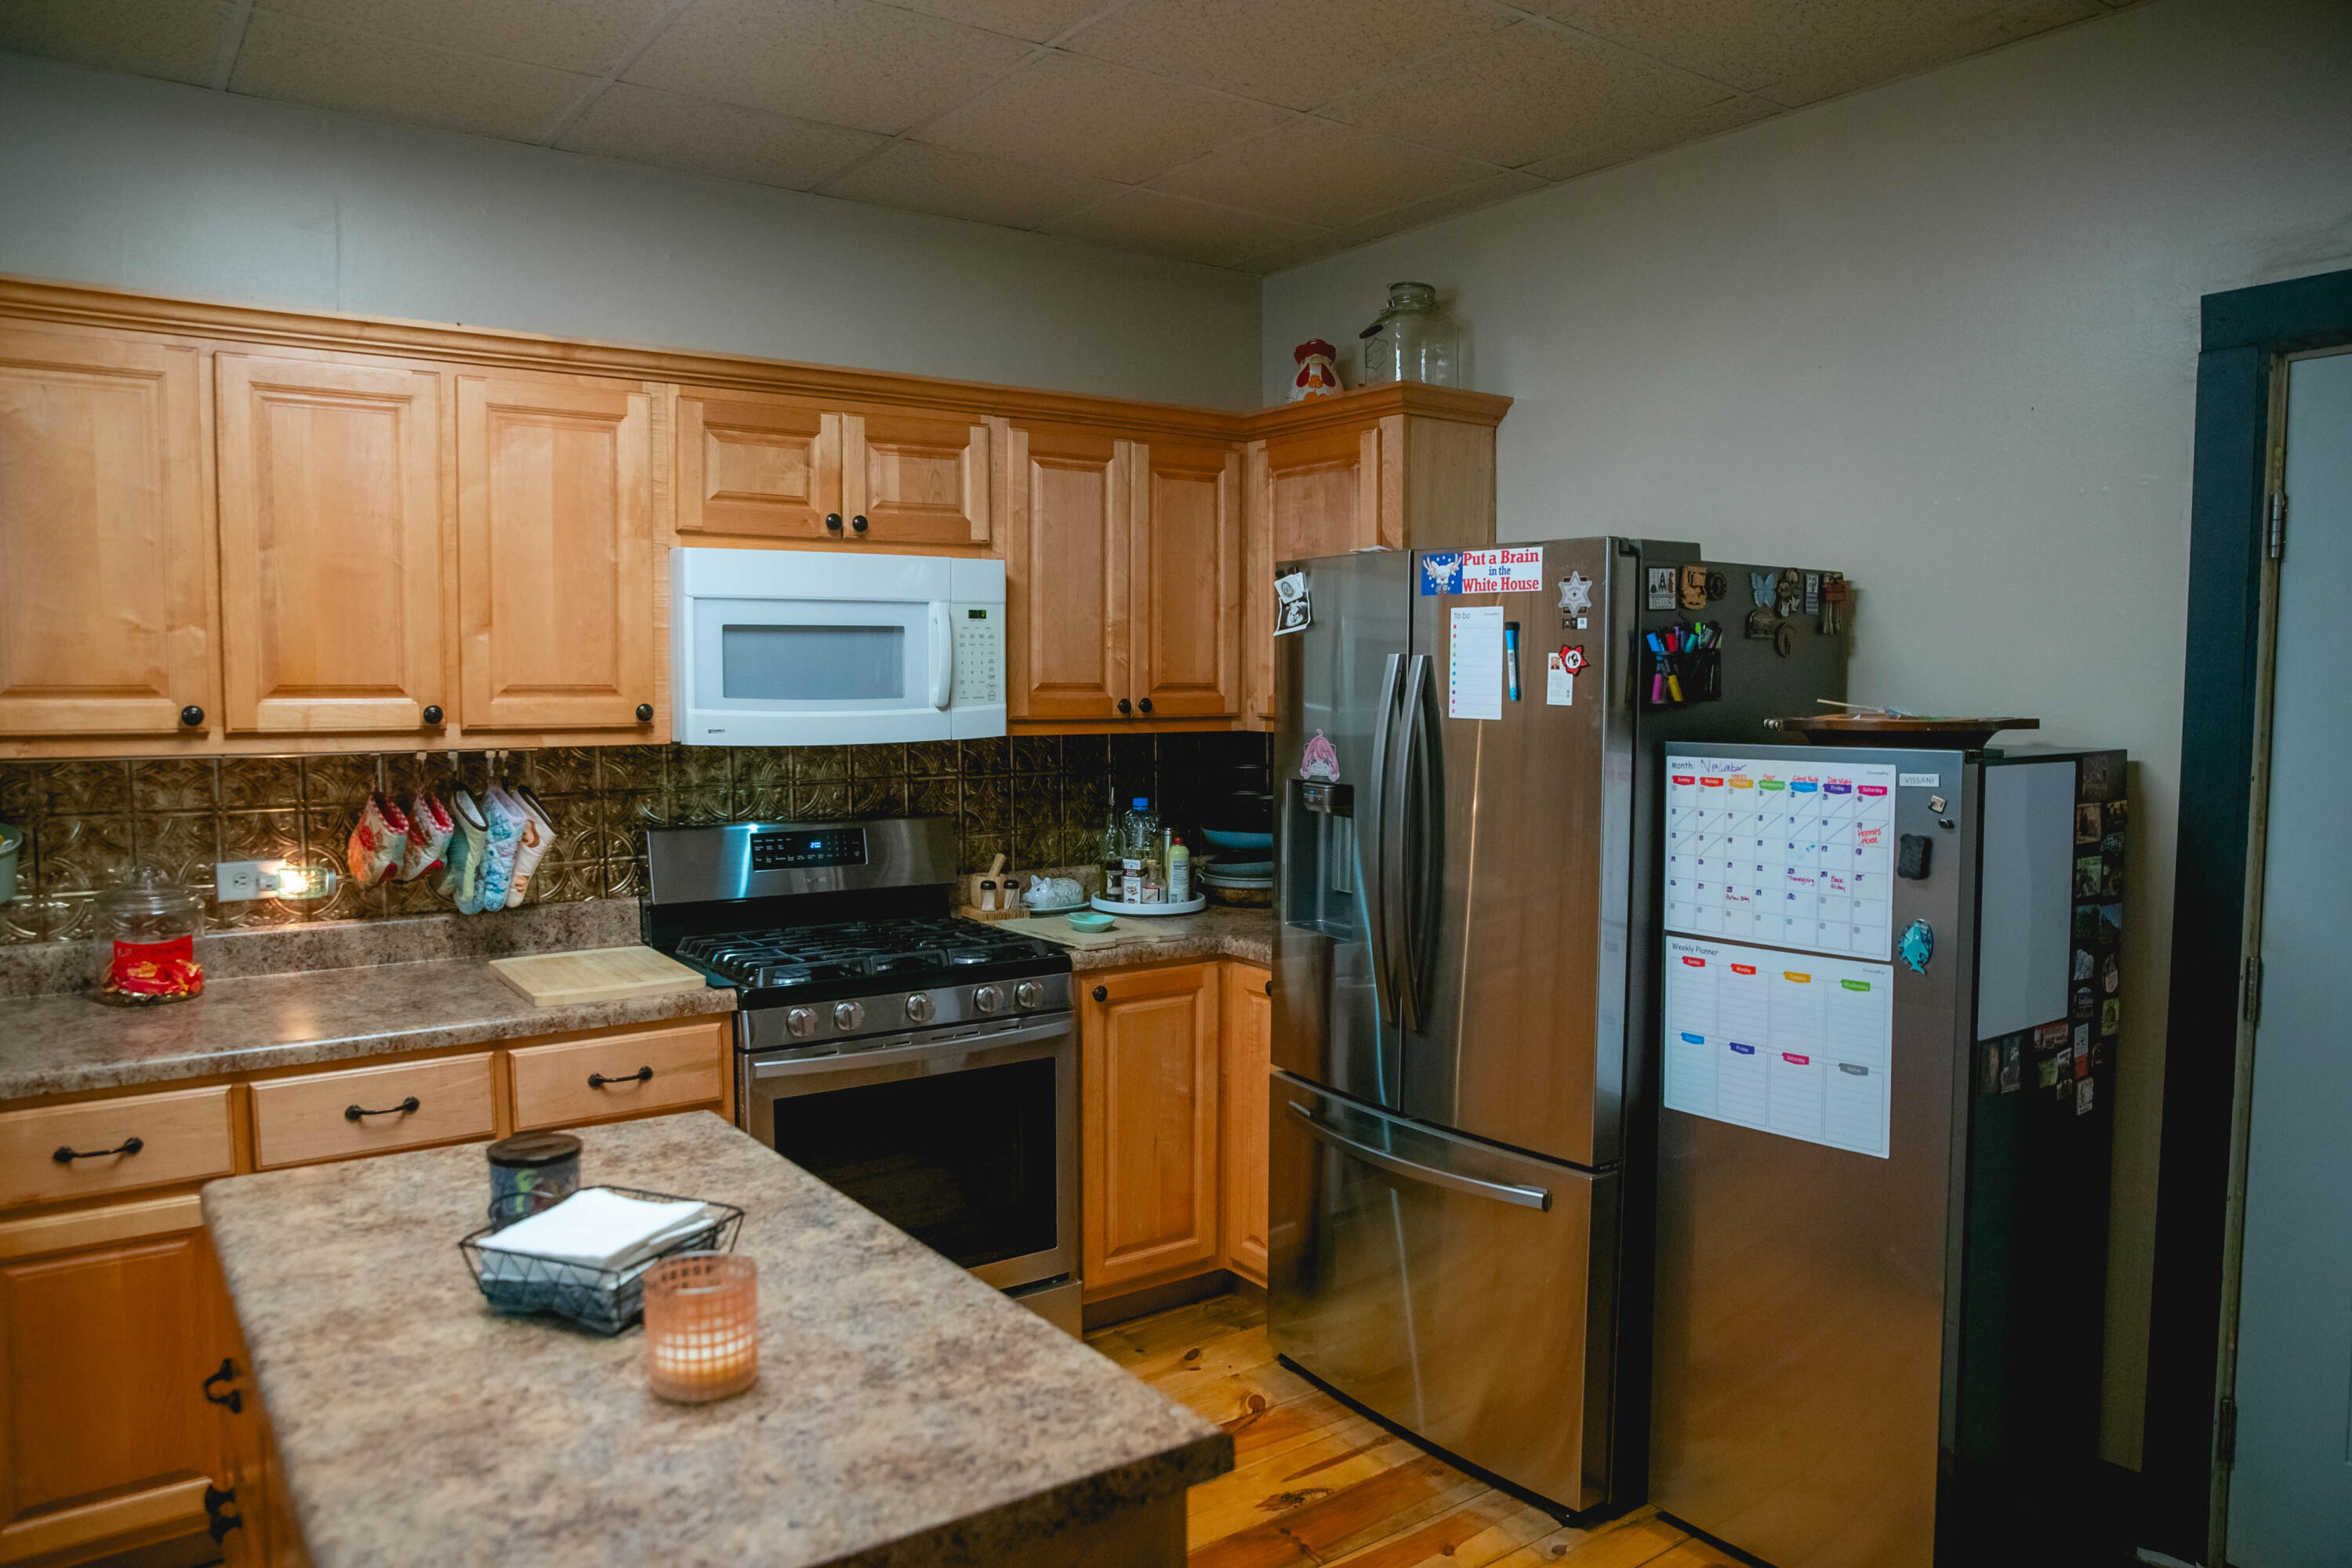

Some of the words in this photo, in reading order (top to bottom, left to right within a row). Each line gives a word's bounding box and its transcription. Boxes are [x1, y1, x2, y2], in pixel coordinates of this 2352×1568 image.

[1463, 552, 1486, 566] Put
[1489, 554, 1497, 564] a
[1501, 549, 1539, 564] Brain
[1489, 566, 1497, 576] in
[1499, 565, 1512, 575] the
[1462, 578, 1498, 593] White
[1501, 577, 1539, 591] House
[1672, 943, 1694, 953] Weekly
[1696, 946, 1719, 956] Planner
